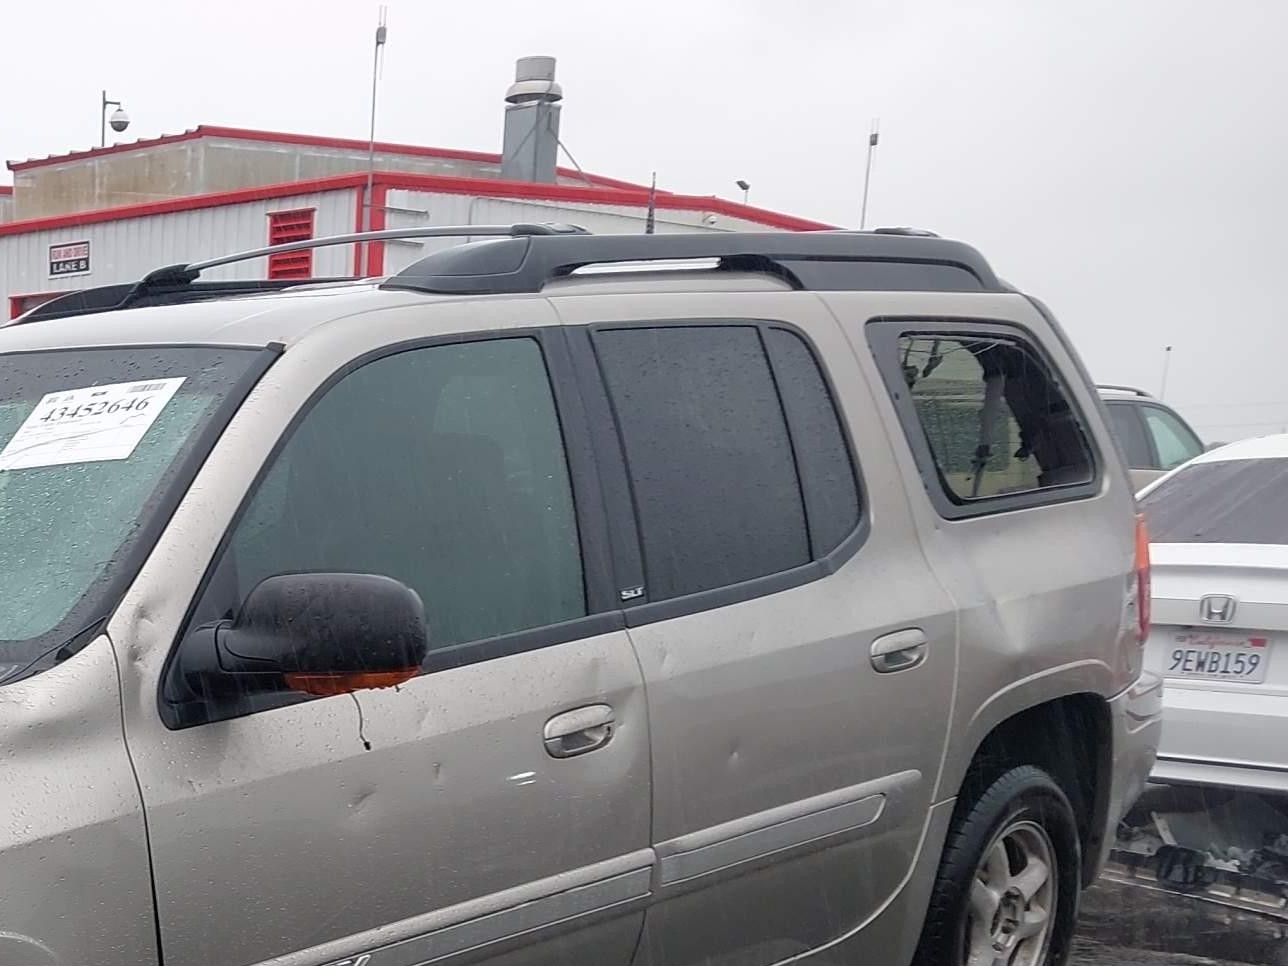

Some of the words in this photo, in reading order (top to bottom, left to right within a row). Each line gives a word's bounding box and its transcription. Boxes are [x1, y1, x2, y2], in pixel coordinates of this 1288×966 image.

[53, 261, 78, 272] LANE
[79, 260, 87, 270] B
[40, 396, 154, 422] 43452646
[621, 586, 643, 600] SLT
[1168, 649, 1260, 675] 9EWB159
